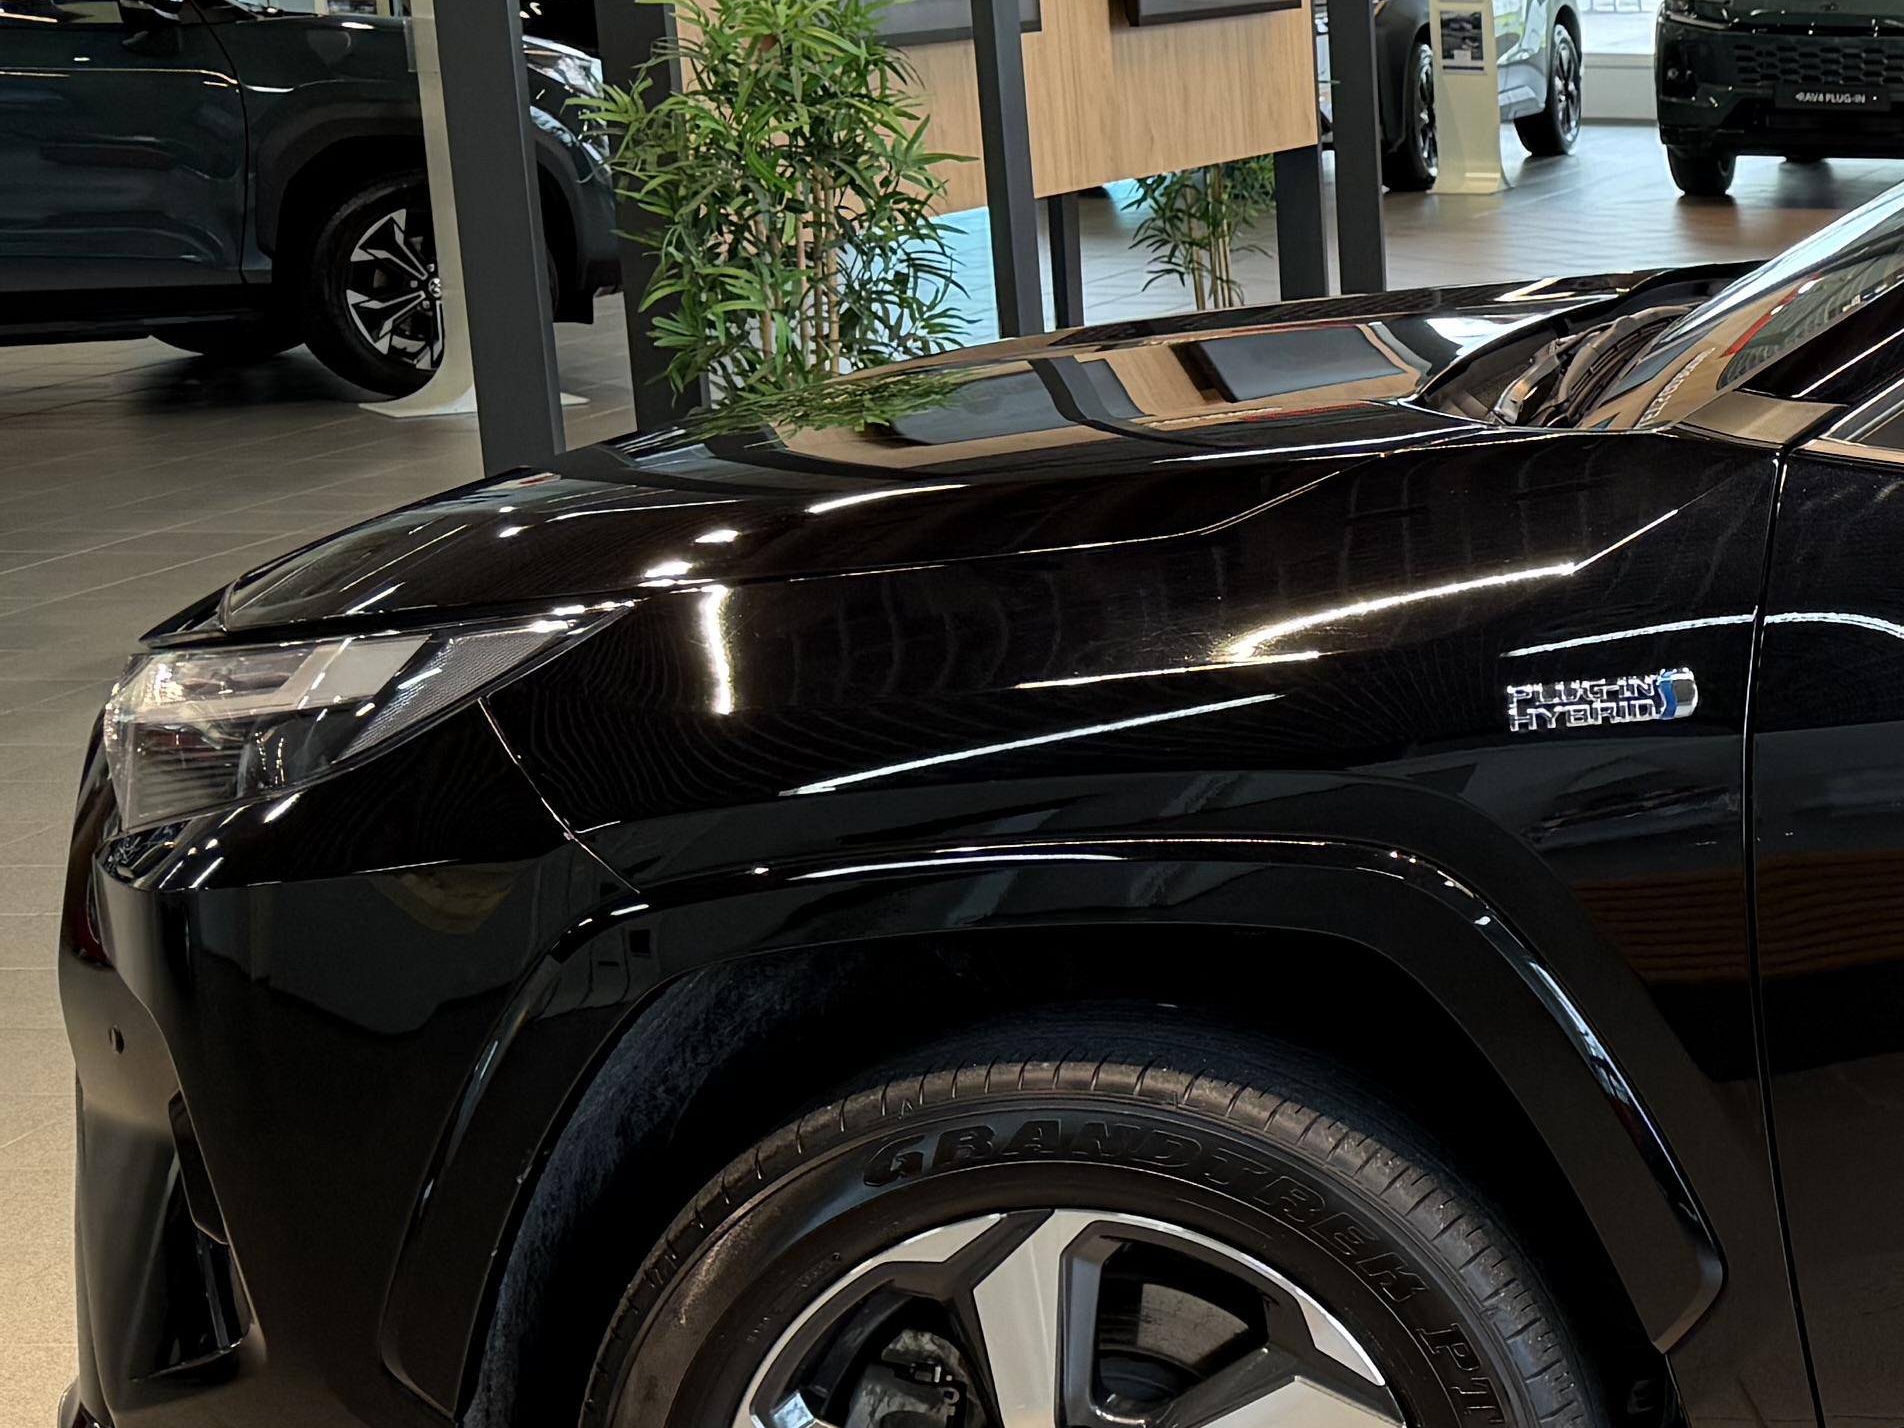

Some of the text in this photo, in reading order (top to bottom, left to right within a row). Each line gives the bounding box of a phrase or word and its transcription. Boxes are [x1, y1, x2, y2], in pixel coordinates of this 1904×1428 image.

[1506, 674, 1660, 710] PLUG-IN
[1508, 700, 1666, 732] HYBRID
[862, 1118, 1431, 1304] GRANDTREK
